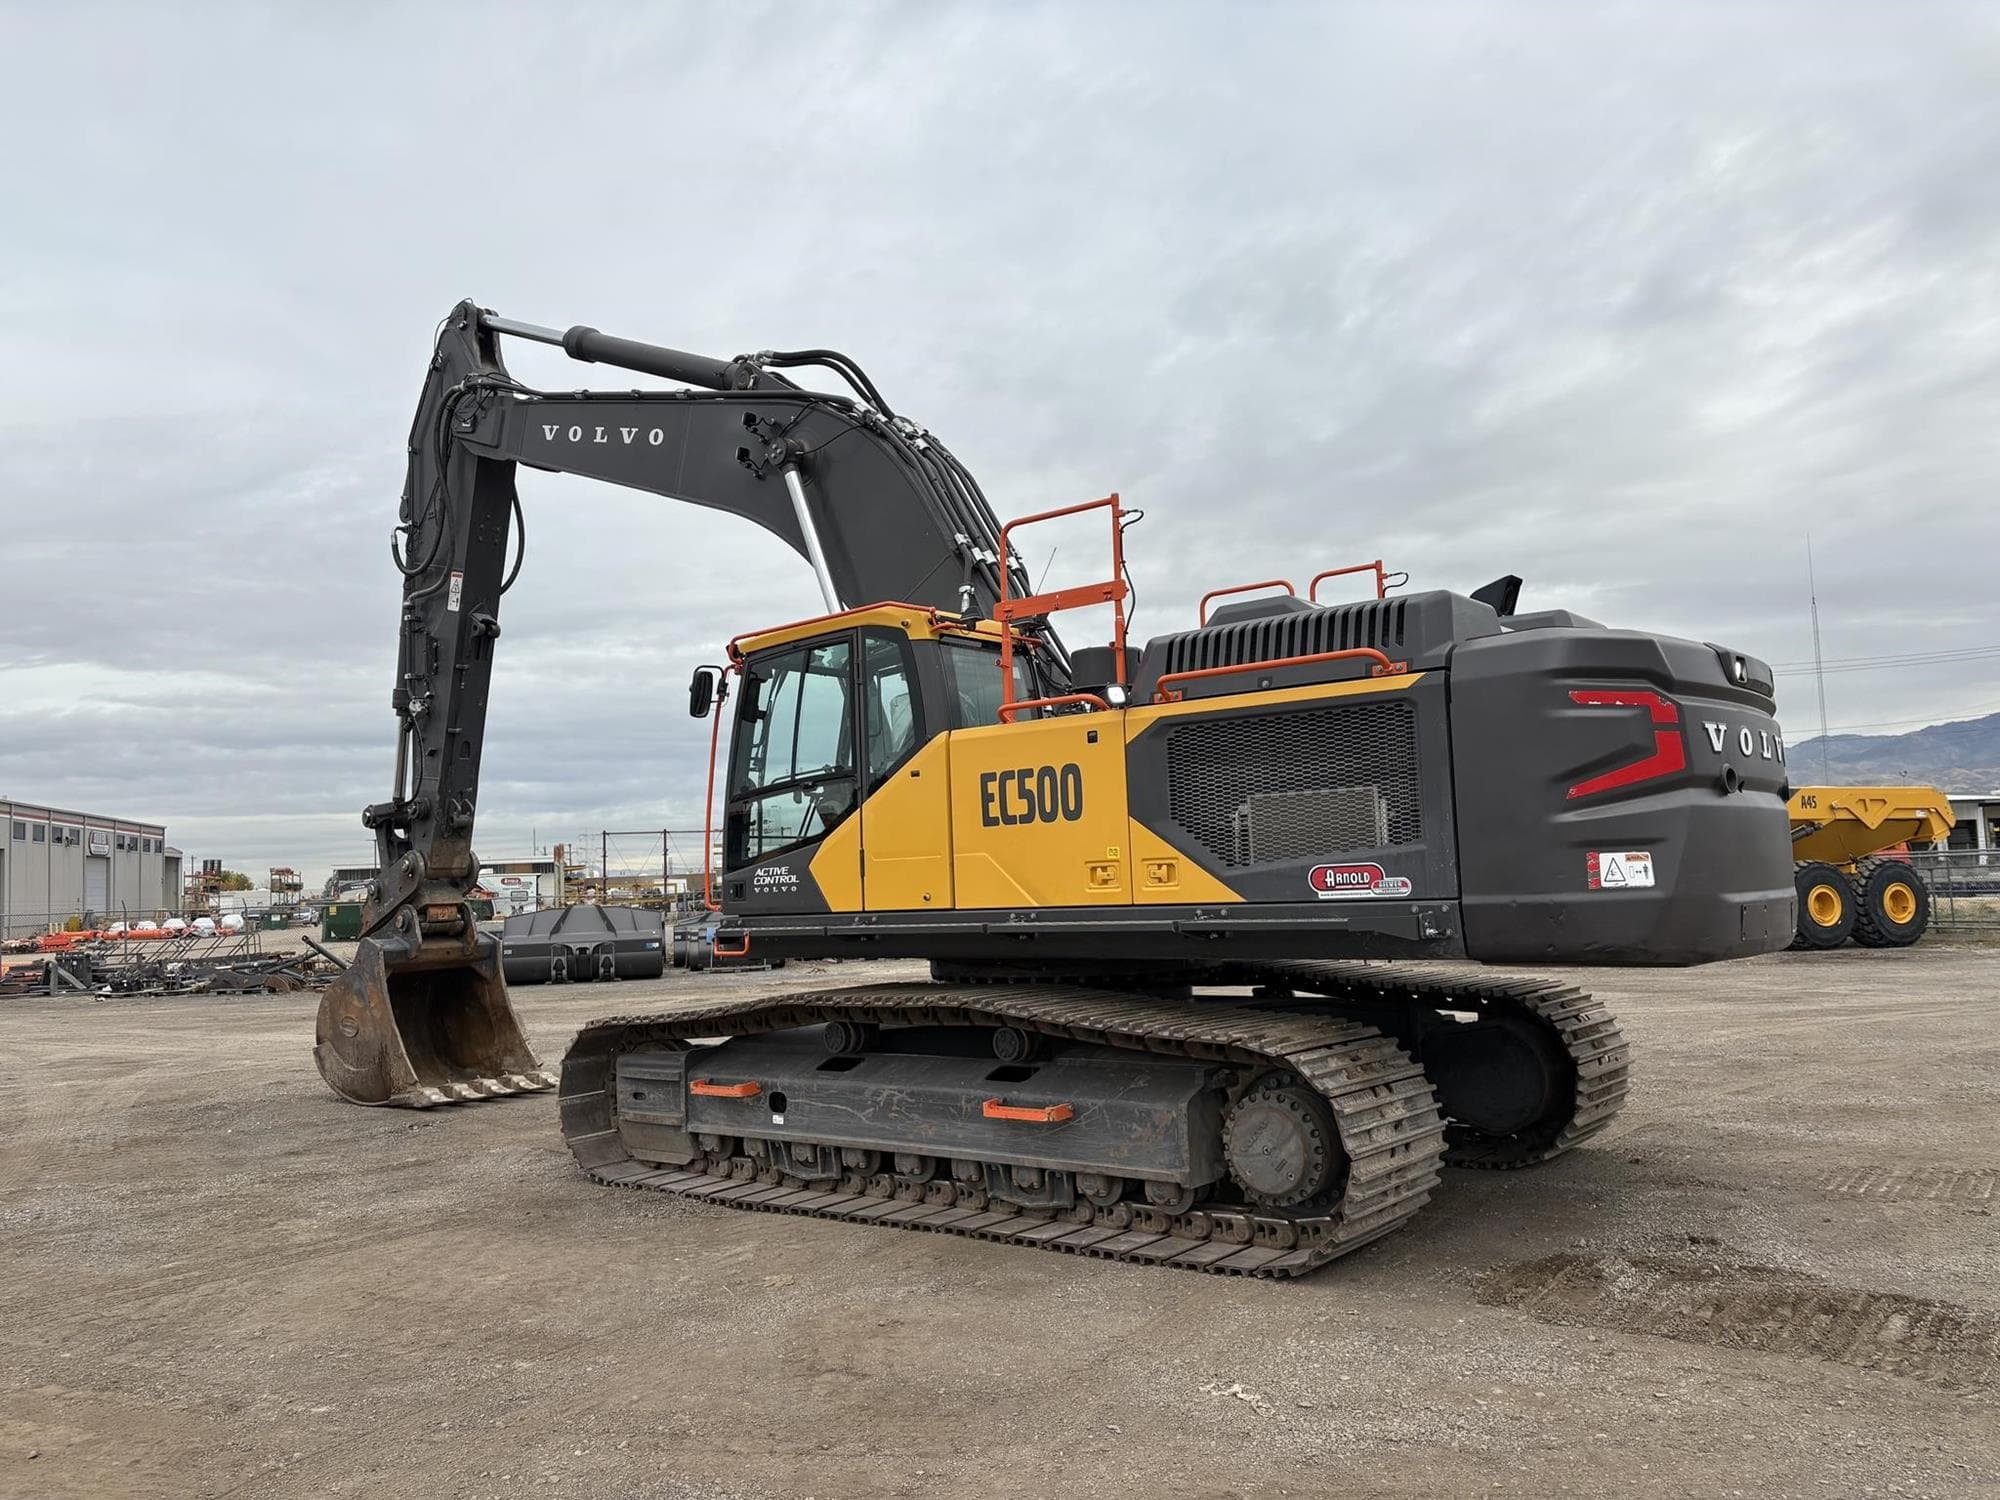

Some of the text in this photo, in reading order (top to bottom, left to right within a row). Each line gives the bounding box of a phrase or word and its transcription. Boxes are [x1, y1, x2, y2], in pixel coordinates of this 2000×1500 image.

[542, 425, 664, 446] VOLVO
[1703, 721, 1785, 764] VOLV
[980, 763, 1083, 827] EC500
[1801, 796, 1817, 809] A45
[753, 874, 800, 885] CONTROL
[754, 866, 789, 876] ACTIVE
